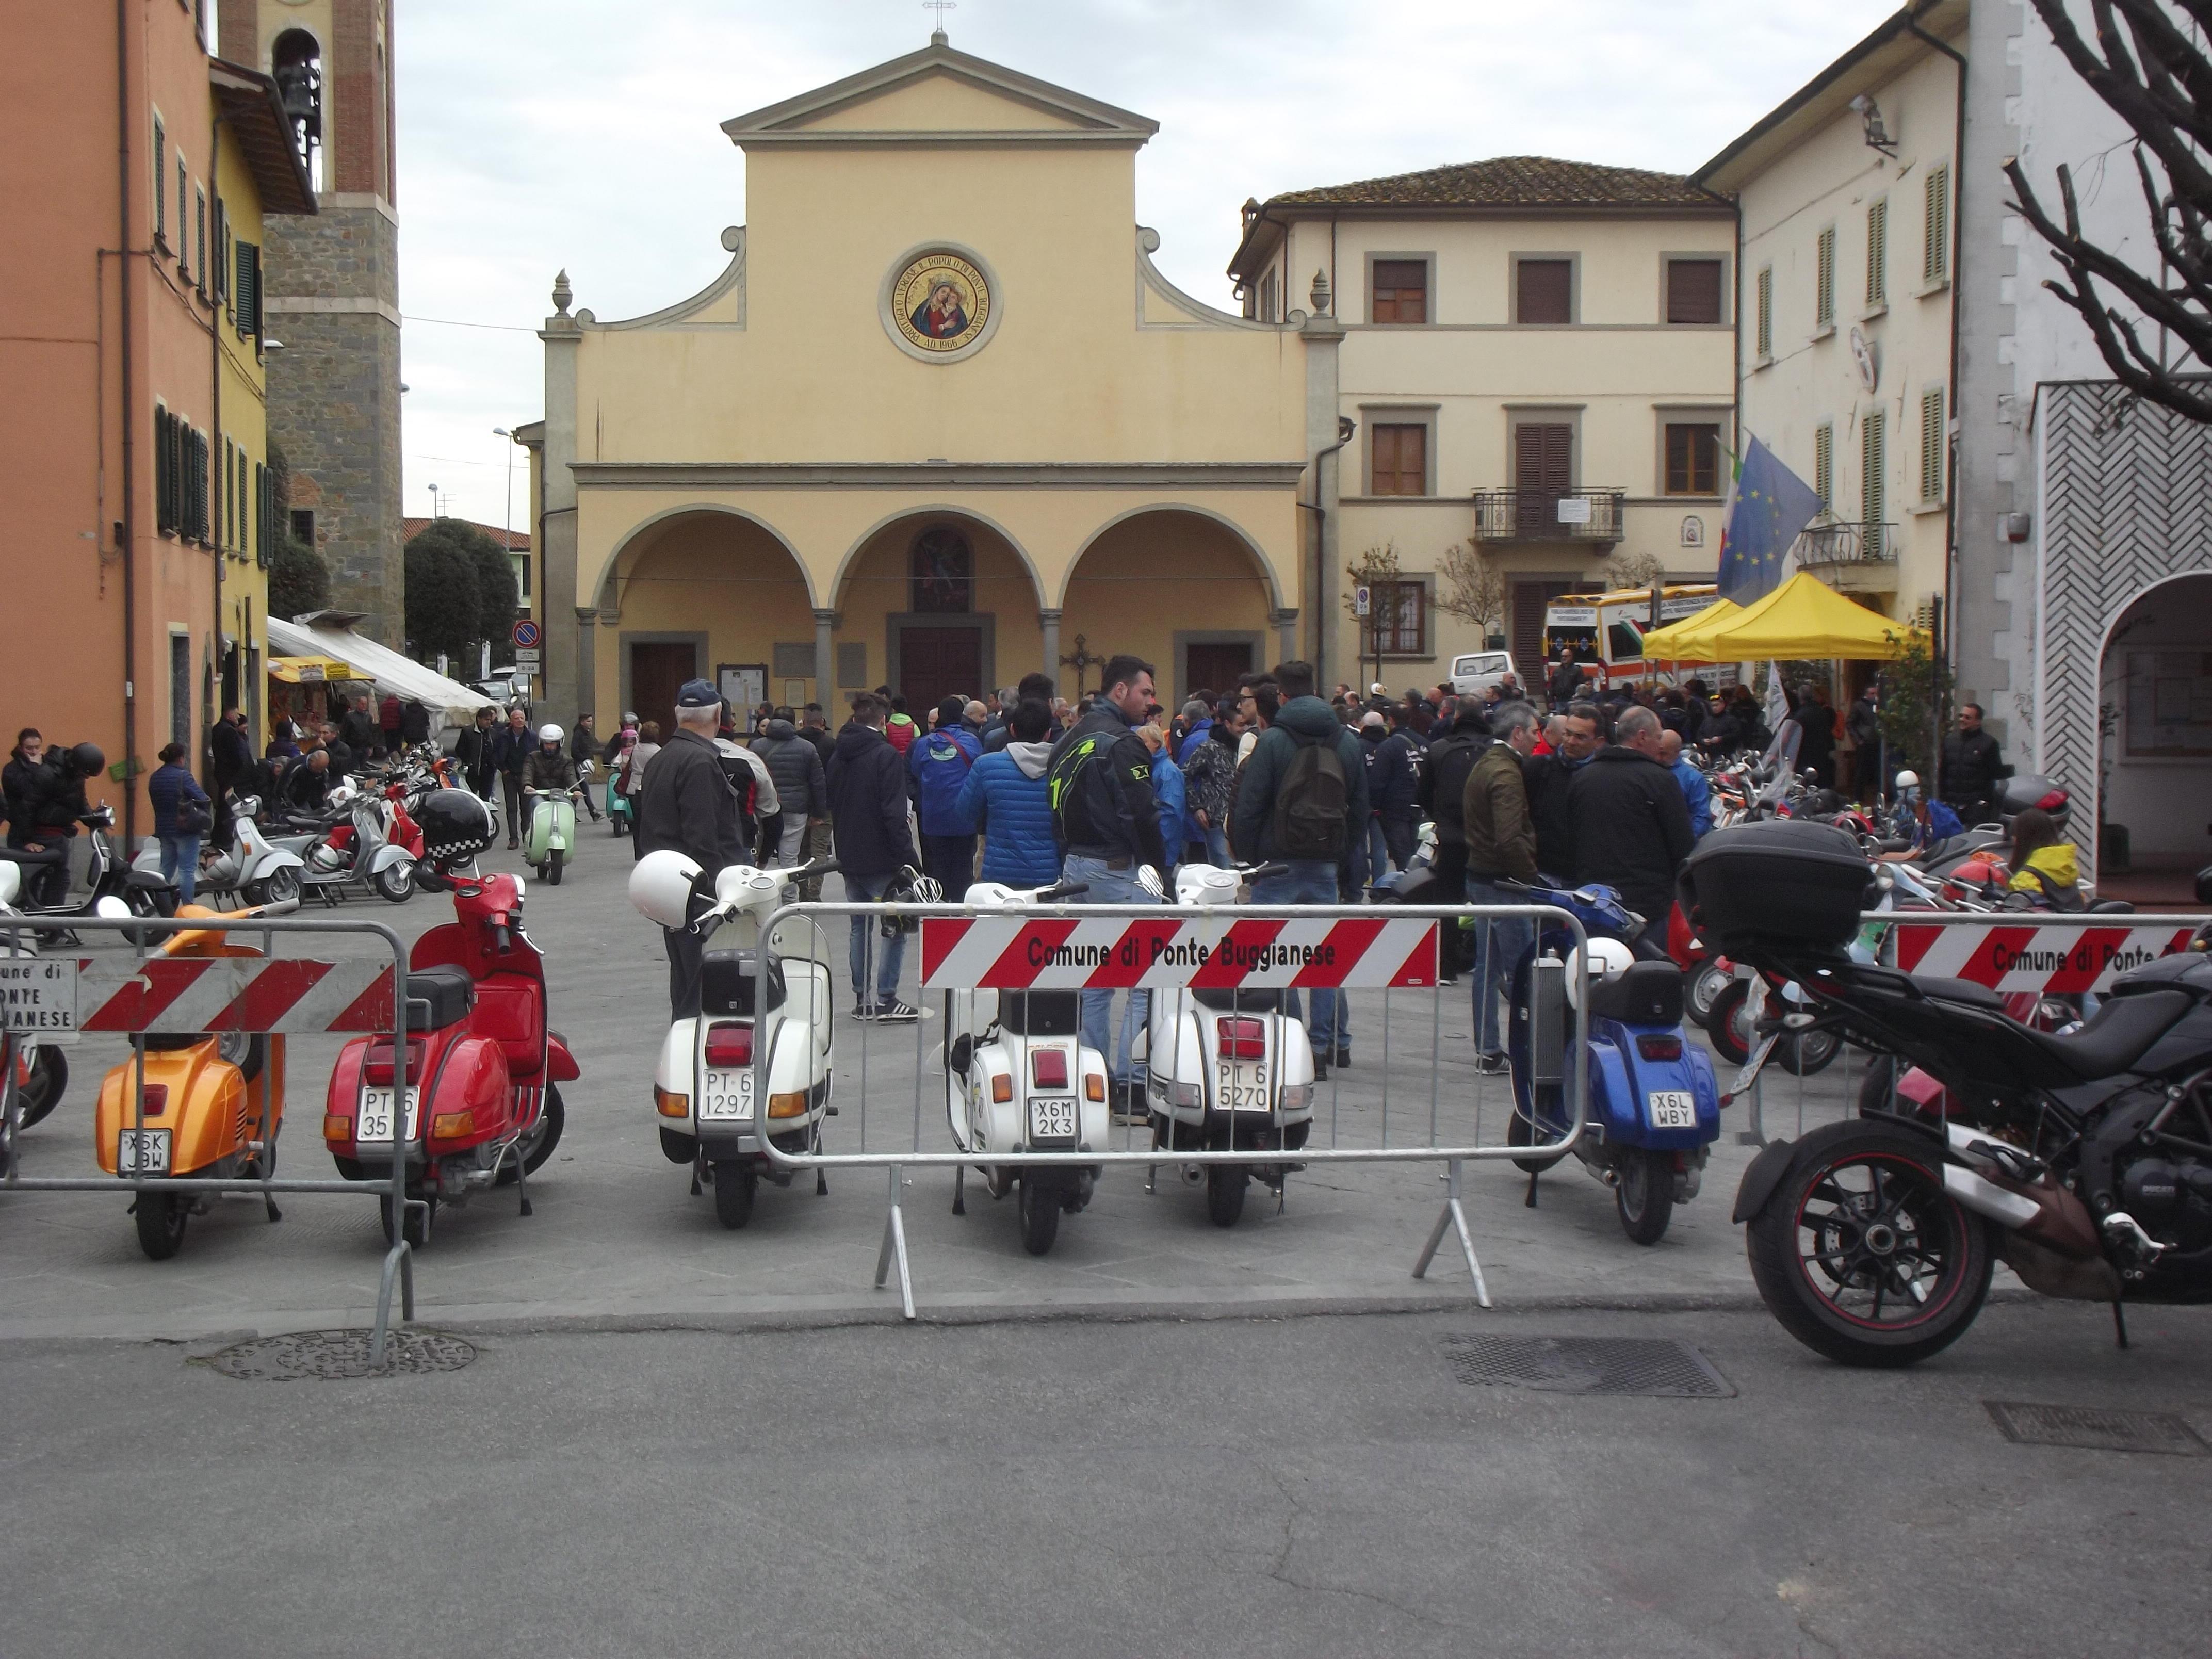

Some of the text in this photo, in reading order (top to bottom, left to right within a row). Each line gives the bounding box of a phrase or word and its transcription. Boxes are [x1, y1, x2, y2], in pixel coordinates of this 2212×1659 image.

[928, 256, 959, 267] POPOLO
[968, 269, 986, 294] PONTE
[940, 339, 957, 349] 1966
[1028, 936, 1336, 972] Comune di Ponte Buggianese
[1993, 944, 2068, 971] Comune
[2077, 945, 2092, 971] di
[45, 963, 61, 979] di
[707, 1073, 751, 1092] PT 6
[1220, 1065, 1266, 1084] PT 6
[365, 1092, 414, 1113] PT 6
[707, 1094, 751, 1114] 1297
[1220, 1086, 1266, 1107] 5270
[1656, 1094, 1688, 1108] X6L
[1038, 1101, 1072, 1117] X6M
[1658, 1109, 1689, 1125] WBY
[1039, 1118, 1072, 1134] 2K3
[129, 1134, 162, 1150] X6K
